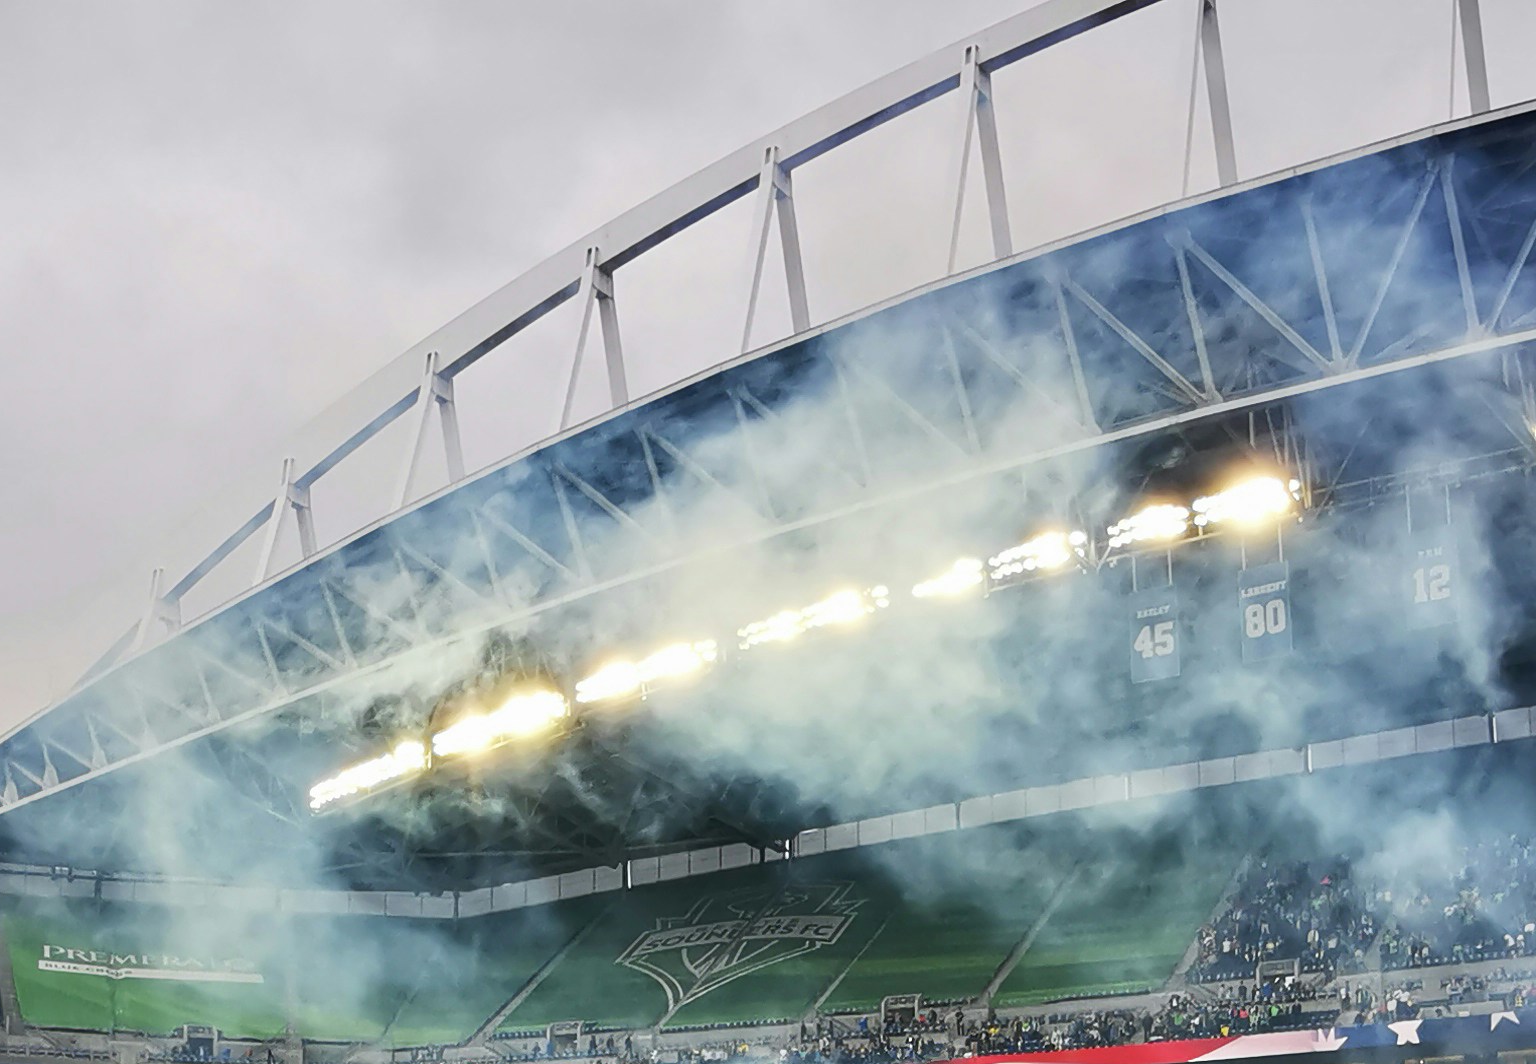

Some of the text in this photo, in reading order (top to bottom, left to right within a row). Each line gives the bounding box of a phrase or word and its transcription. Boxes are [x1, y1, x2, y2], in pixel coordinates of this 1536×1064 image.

[1414, 564, 1451, 604] 12
[1244, 598, 1287, 639] 80
[1133, 620, 1176, 659] 45
